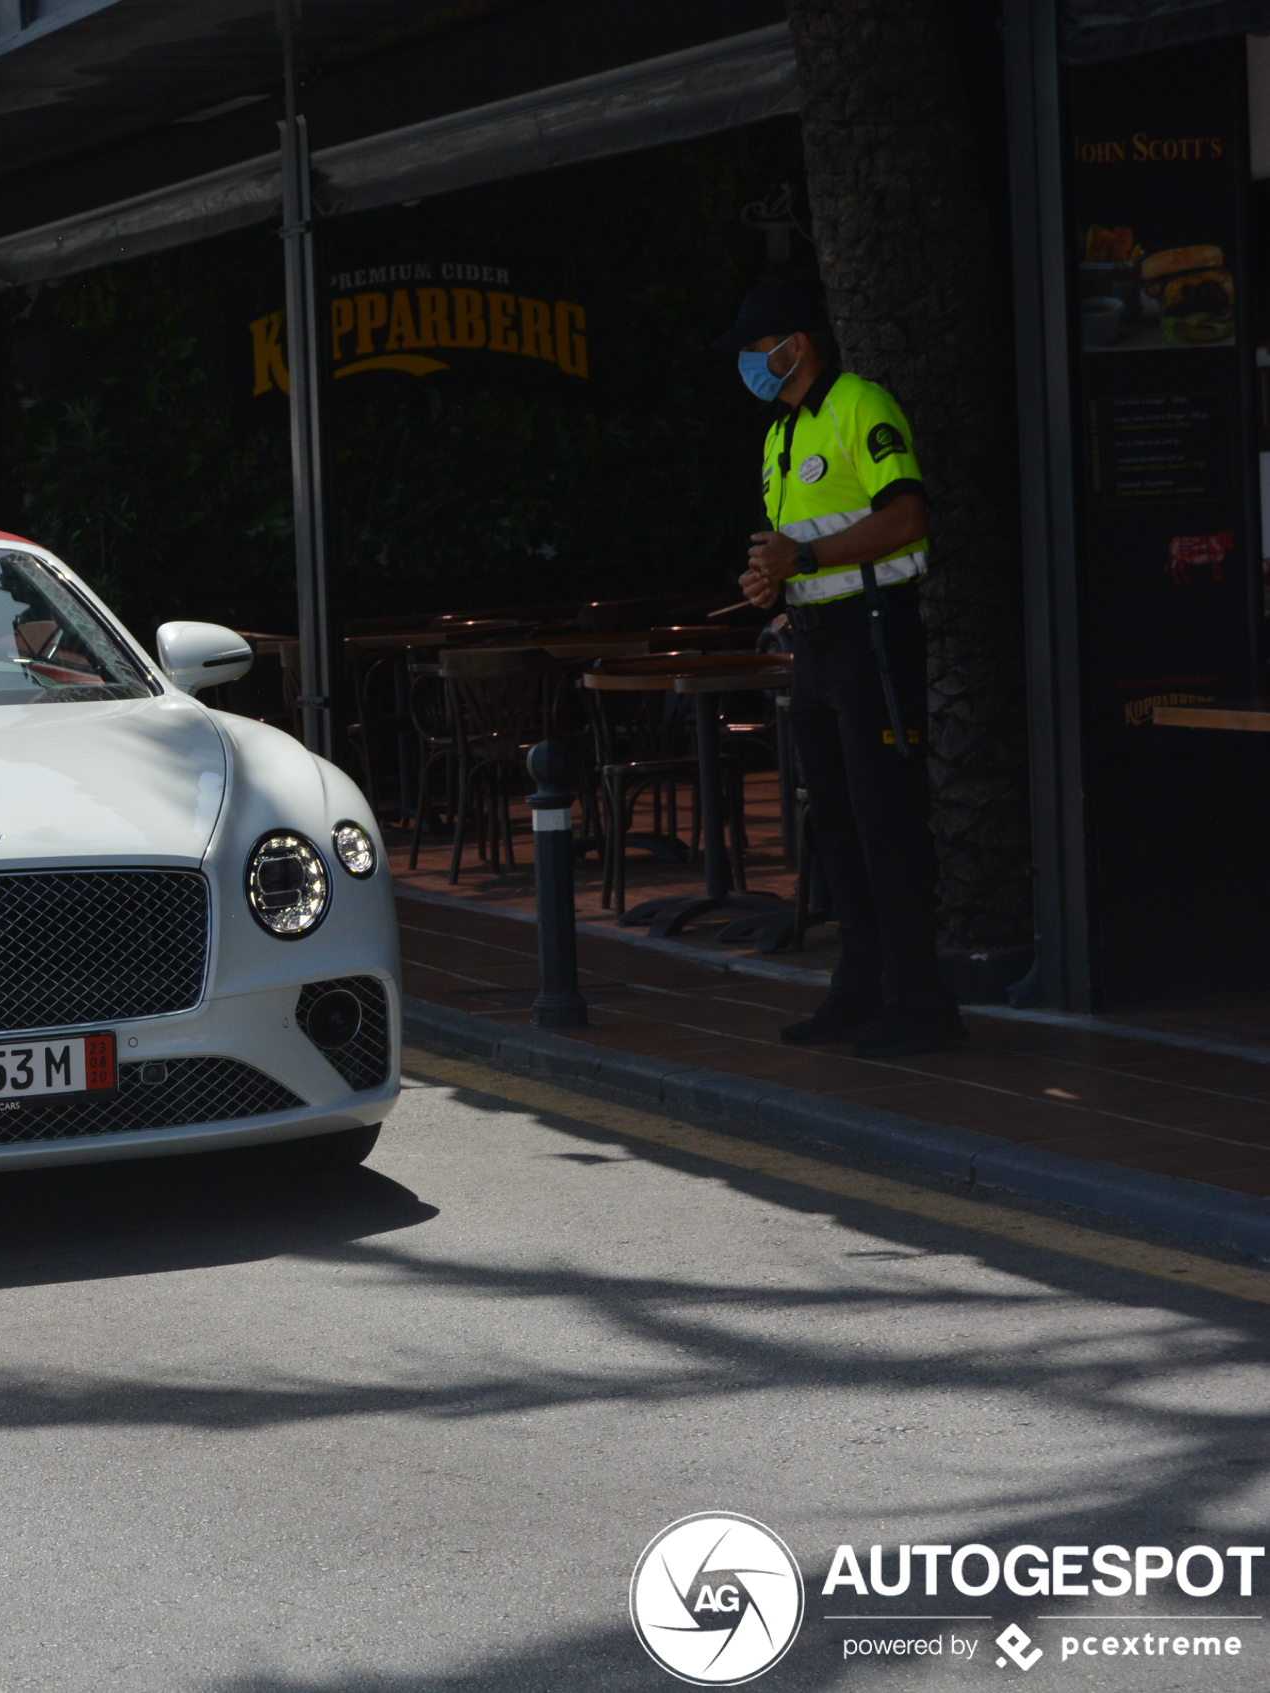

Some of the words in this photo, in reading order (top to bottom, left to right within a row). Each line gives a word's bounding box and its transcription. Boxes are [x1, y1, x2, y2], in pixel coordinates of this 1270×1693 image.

[1132, 131, 1224, 163] SCOTT'S
[440, 262, 511, 286] CIDER
[248, 285, 590, 398] KPPARBERG
[89, 1041, 106, 1054] 23
[44, 1044, 72, 1088] M
[89, 1056, 106, 1069] 08
[90, 1071, 107, 1083] 20
